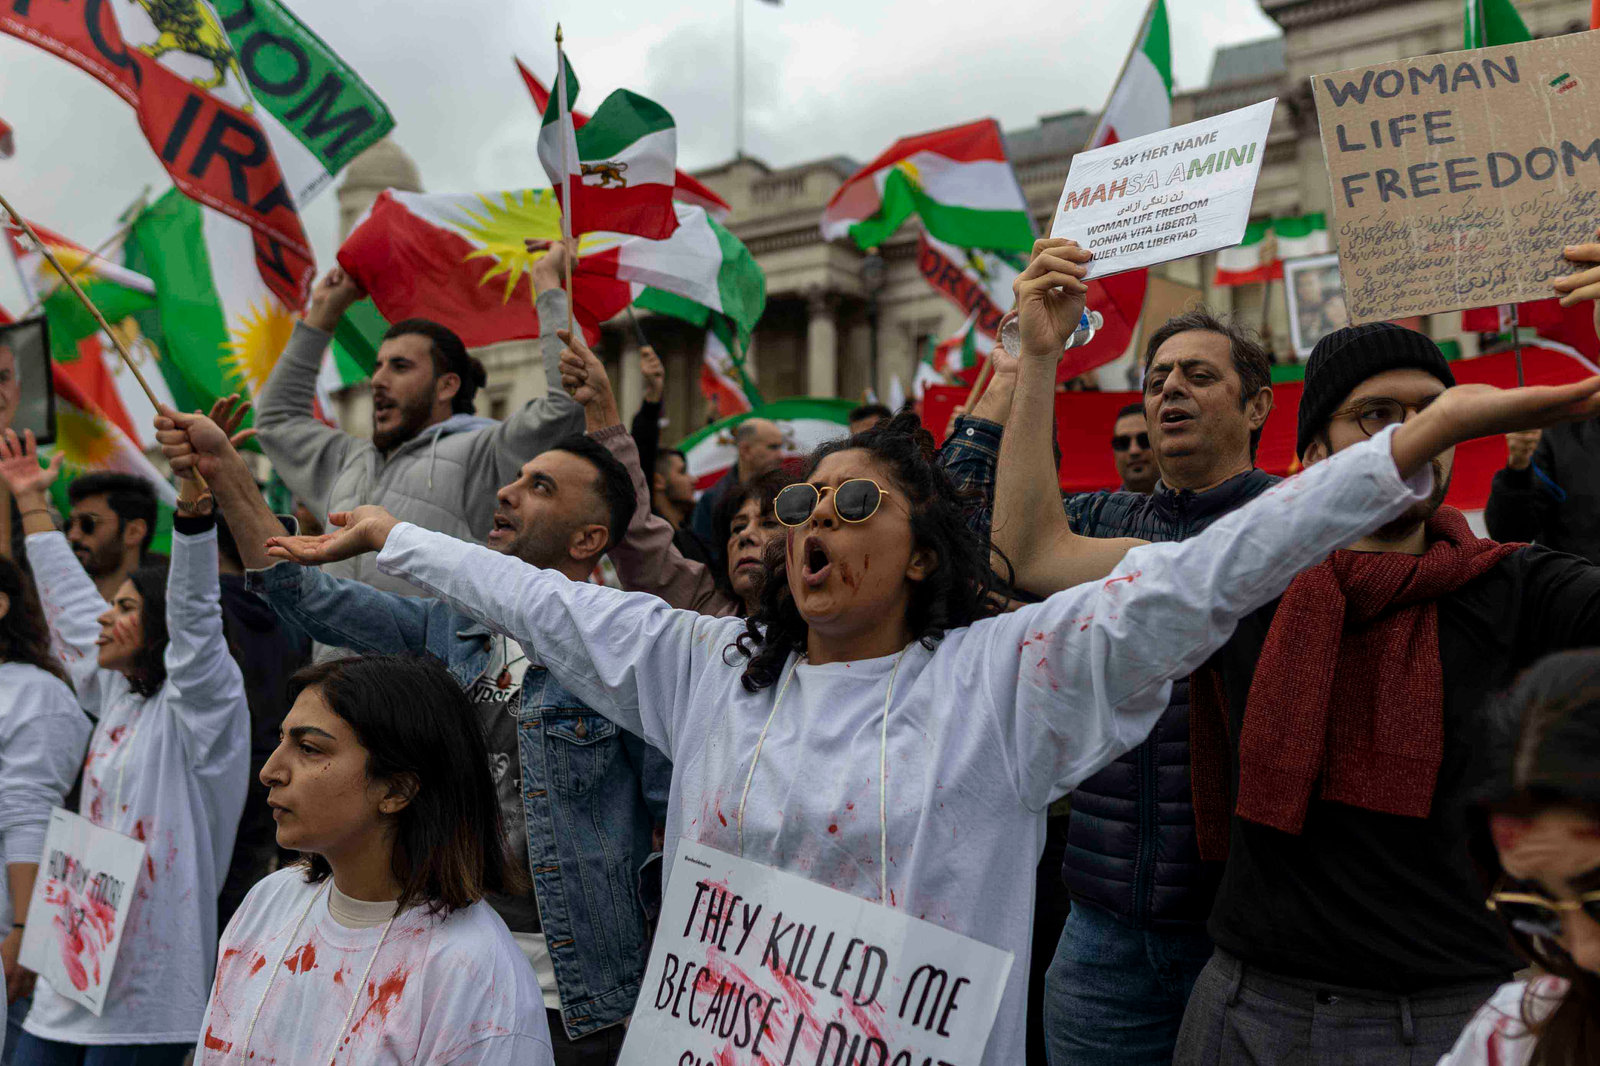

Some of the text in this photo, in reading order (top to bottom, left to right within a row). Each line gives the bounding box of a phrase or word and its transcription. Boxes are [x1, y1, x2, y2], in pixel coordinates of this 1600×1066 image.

[1323, 55, 1520, 107] WOMAN
[1112, 131, 1218, 170] SAY HER NAME
[1336, 110, 1455, 152] LIFE
[1063, 142, 1257, 212] MAHSA AMINI
[1341, 138, 1600, 208] FREEDOM
[1087, 198, 1209, 236] WOMAN LIFE FREEDOM
[1089, 212, 1198, 249] DONNA VITA LIBERTÀ
[1119, 240, 1144, 254] VIDA
[1147, 228, 1198, 249] LIBERTAD
[682, 881, 972, 1039] THEY KILLED ME
[655, 952, 782, 1057] BECAUSE
